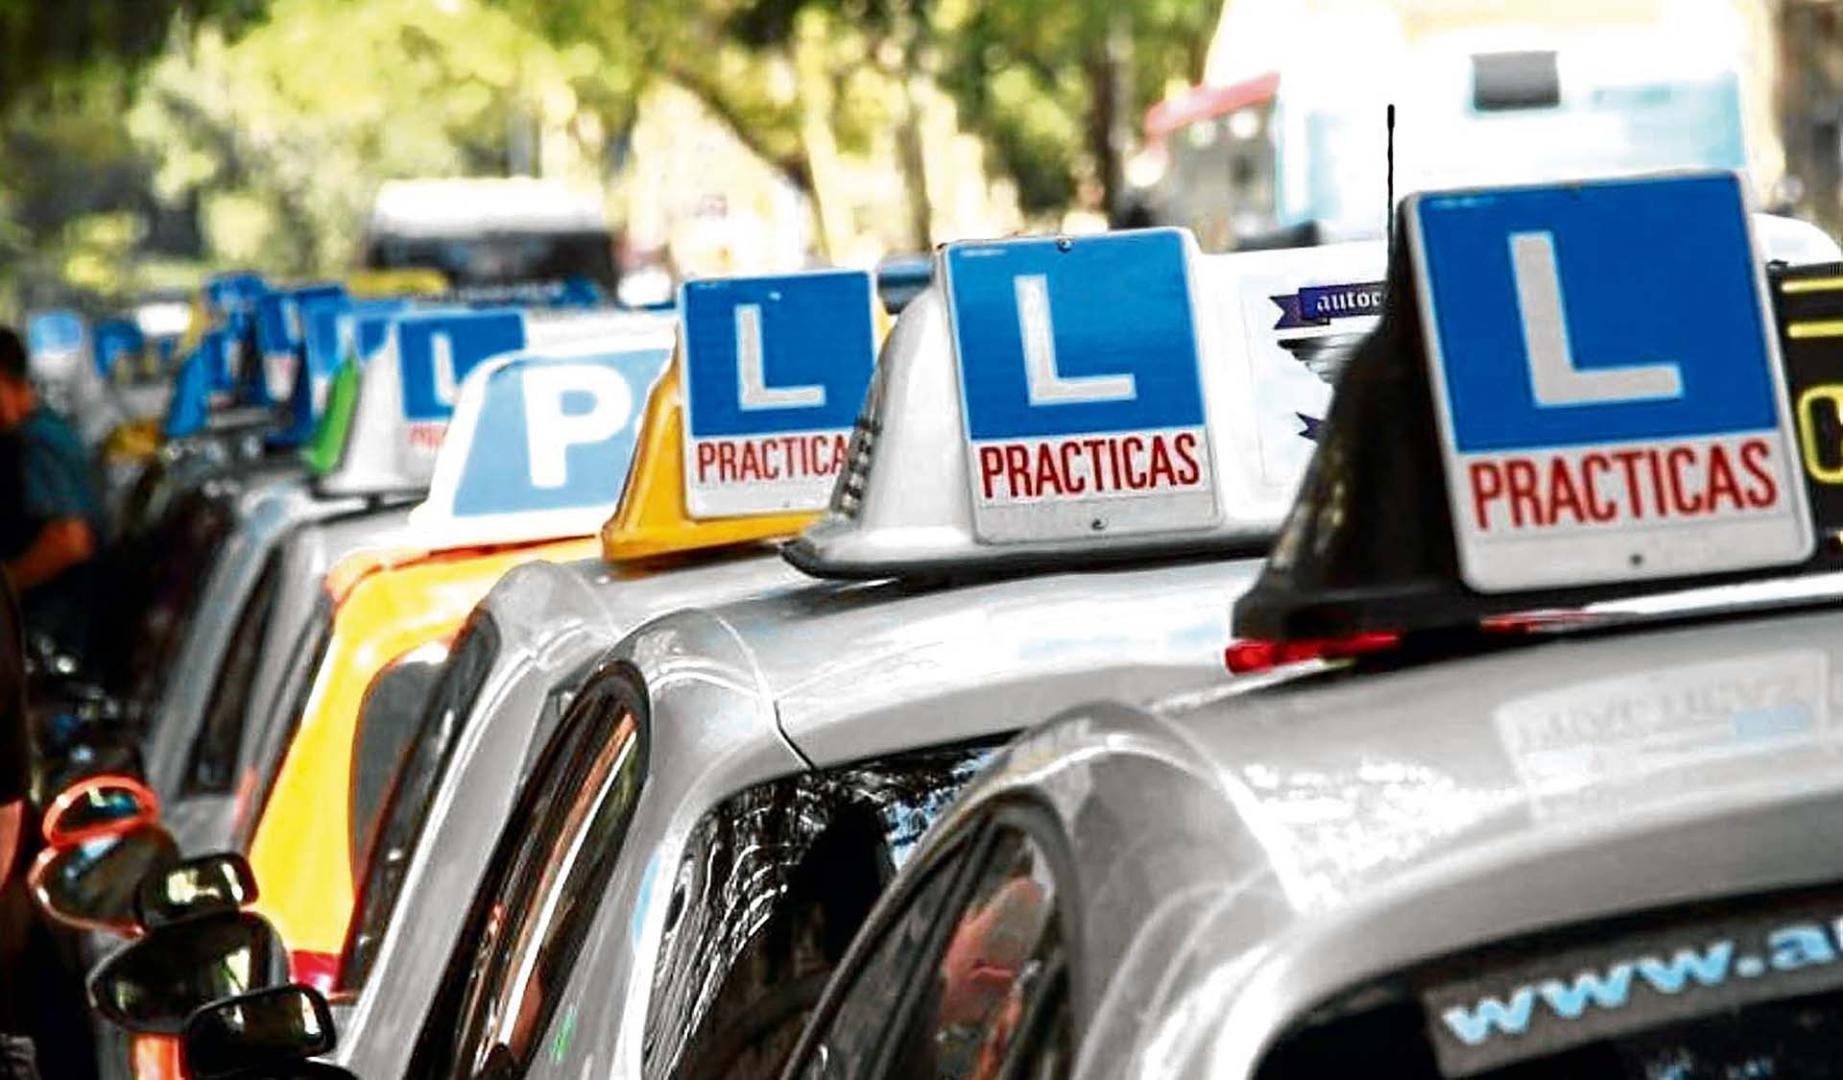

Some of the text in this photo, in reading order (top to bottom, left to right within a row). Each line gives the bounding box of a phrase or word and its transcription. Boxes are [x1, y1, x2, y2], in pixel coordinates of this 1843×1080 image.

[735, 303, 826, 412] L
[1013, 273, 1137, 406] L
[1508, 230, 1683, 409] L
[979, 433, 1200, 499] PRACTICAS
[1468, 439, 1779, 531] PRACTICAS
[1443, 916, 1843, 1043] www.a
